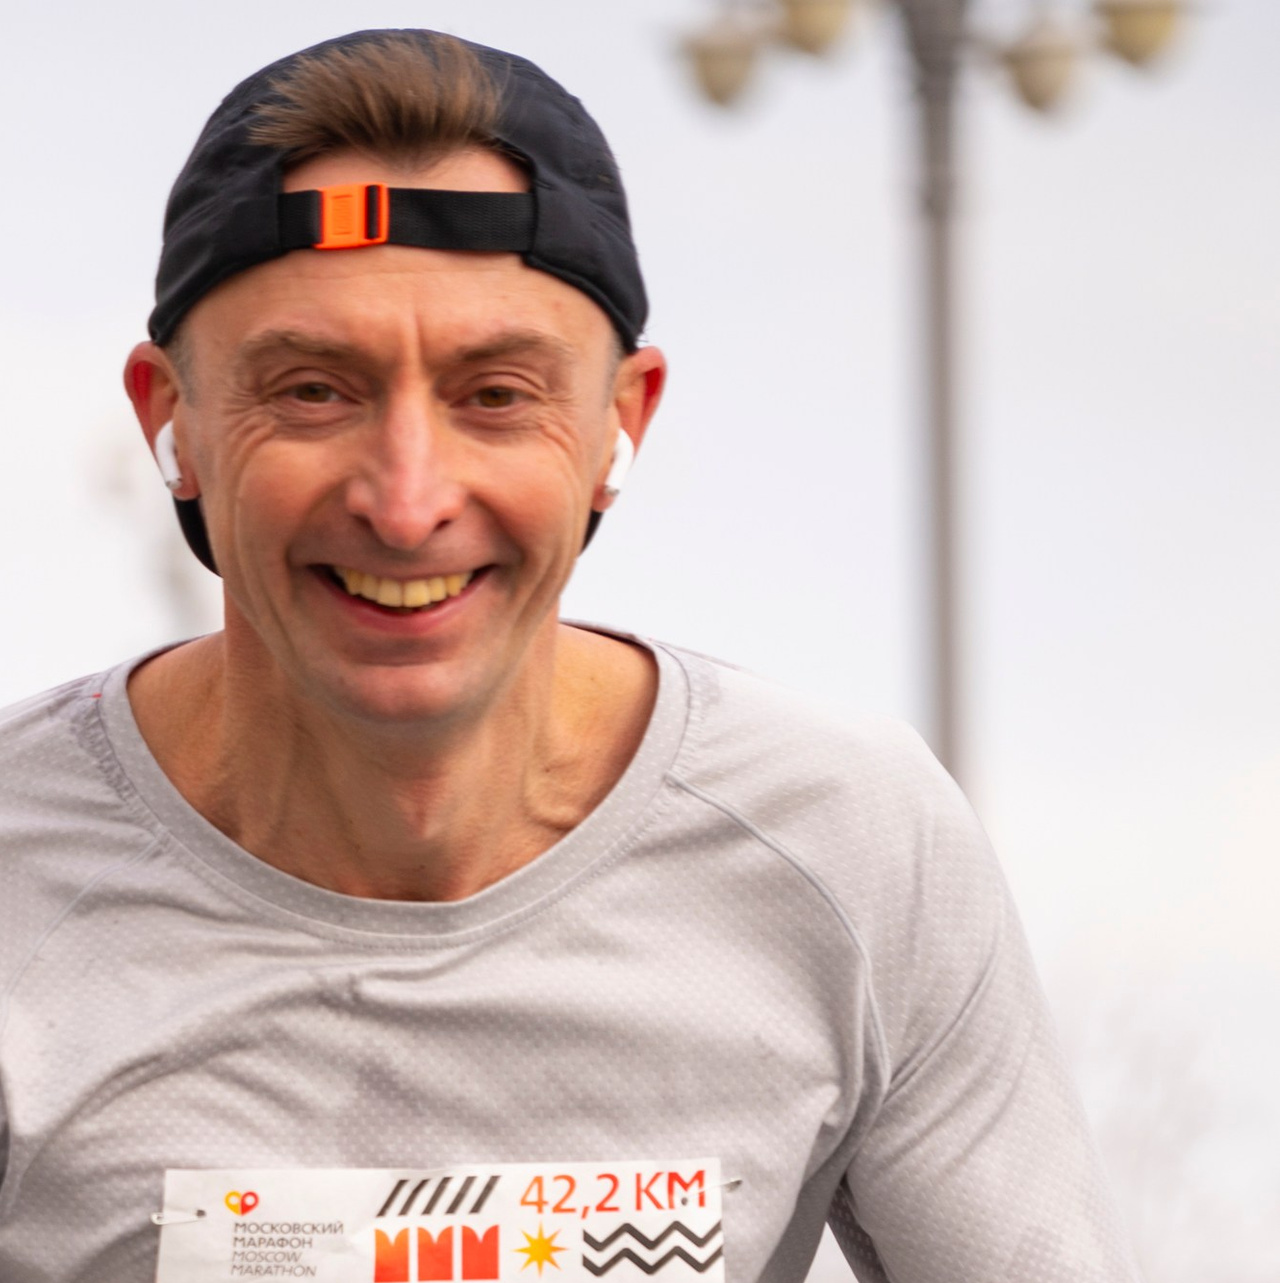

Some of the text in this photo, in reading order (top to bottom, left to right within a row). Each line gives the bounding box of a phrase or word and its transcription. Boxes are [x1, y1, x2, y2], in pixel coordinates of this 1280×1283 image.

[520, 1174, 620, 1219] 42,2
[233, 1221, 344, 1235] МОСКОВСКИЙ
[233, 1237, 313, 1249] МАРАФОН
[232, 1251, 302, 1263] MOSCOW
[231, 1265, 317, 1277] MARATHON
